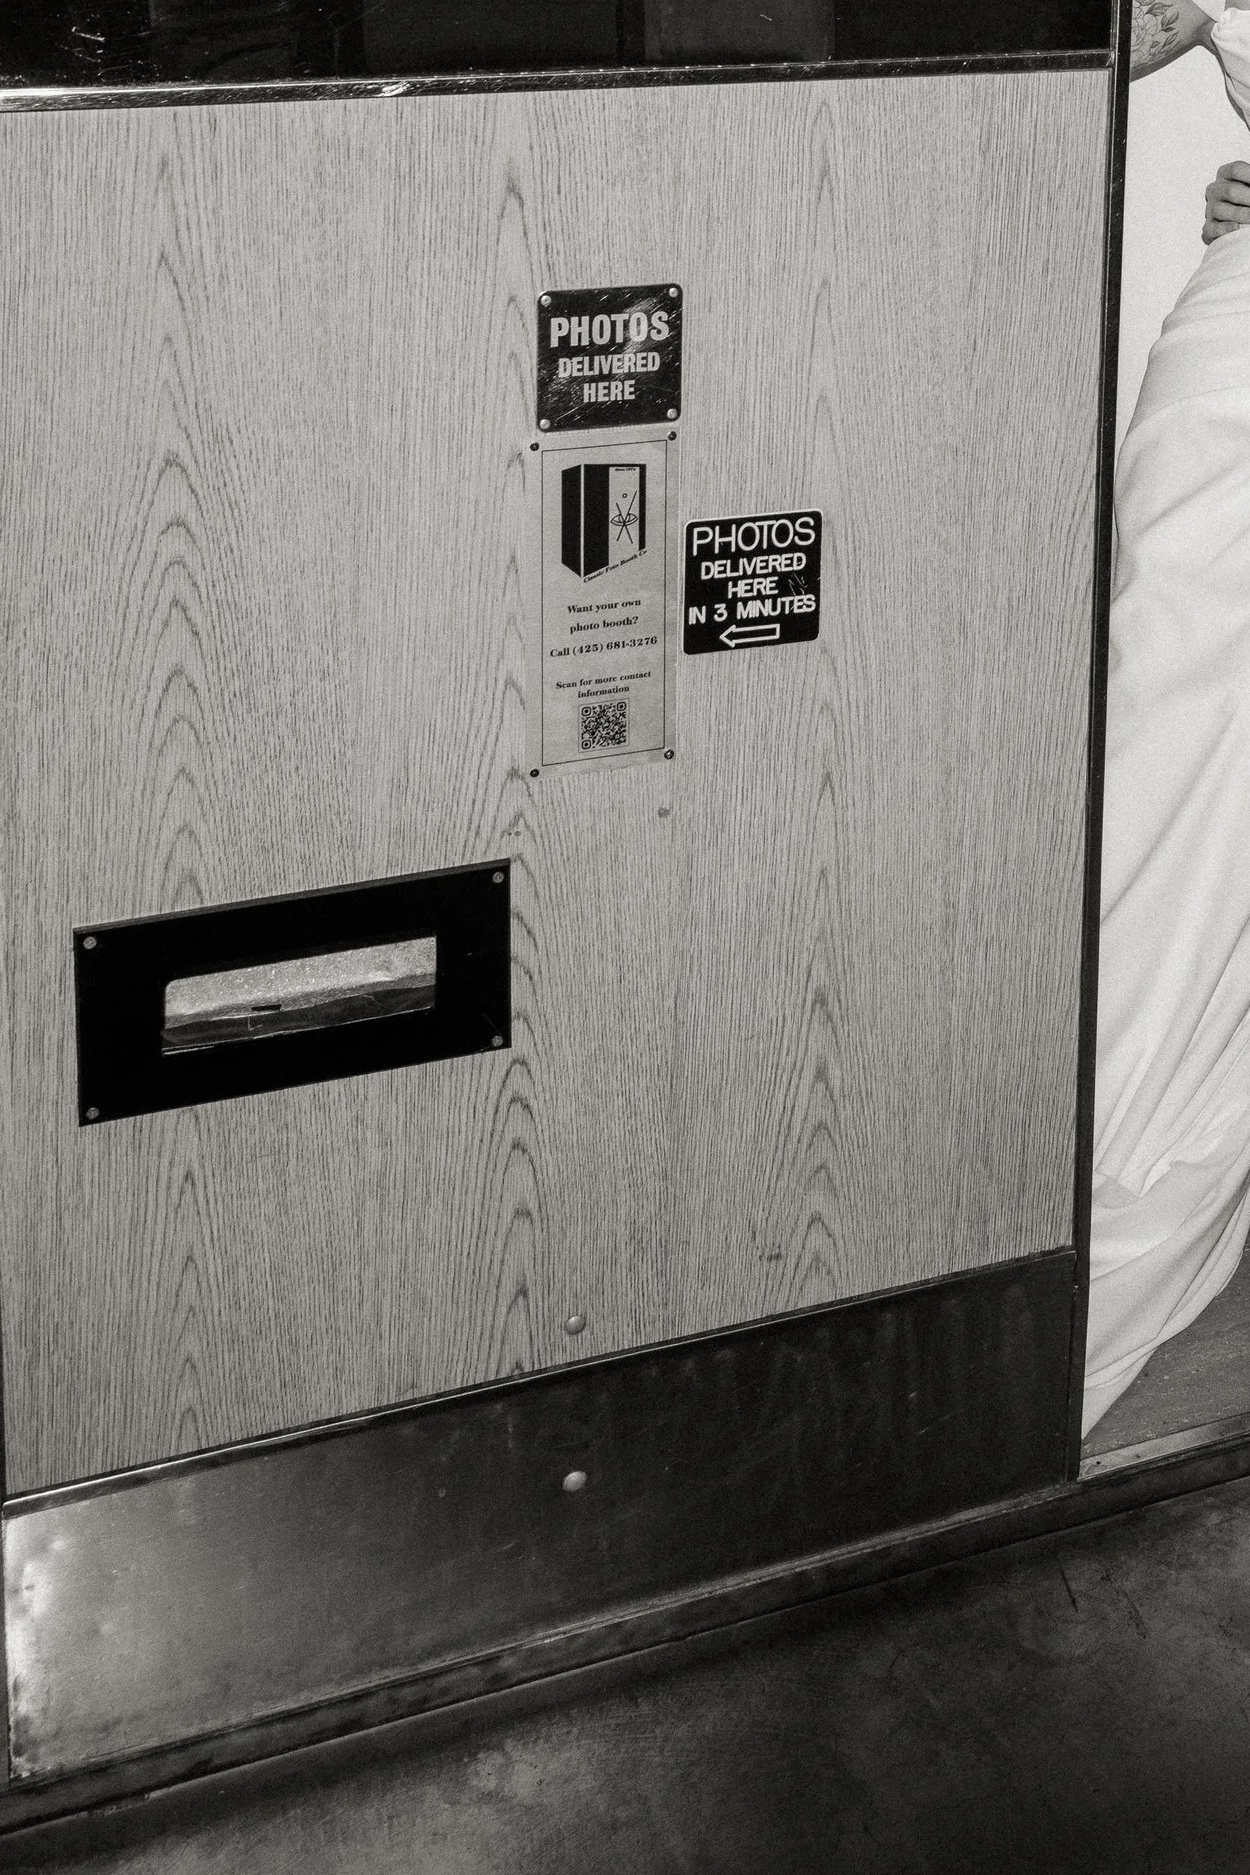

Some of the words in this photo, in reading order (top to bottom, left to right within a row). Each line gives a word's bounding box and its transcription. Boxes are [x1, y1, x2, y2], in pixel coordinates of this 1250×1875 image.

[550, 310, 670, 348] PHOTOS
[558, 351, 661, 378] DELIVERED
[583, 380, 636, 403] HERE
[692, 516, 816, 557] PHOTOS
[701, 552, 807, 580] DELIVERED
[727, 576, 779, 599] HERE
[567, 604, 593, 614] Want
[595, 602, 619, 613] your
[621, 599, 641, 607] own
[688, 605, 706, 625] IN
[713, 603, 728, 622] 3
[736, 594, 816, 620] MINUTES
[570, 622, 600, 635] photo
[602, 616, 639, 628] booth?
[550, 647, 570, 658] Call
[572, 642, 604, 656] (425)
[606, 636, 658, 651] 681-3276
[555, 681, 577, 690] Scan
[579, 678, 593, 687] for
[594, 676, 618, 685] more
[620, 671, 652, 681] contact
[577, 685, 630, 699] information
